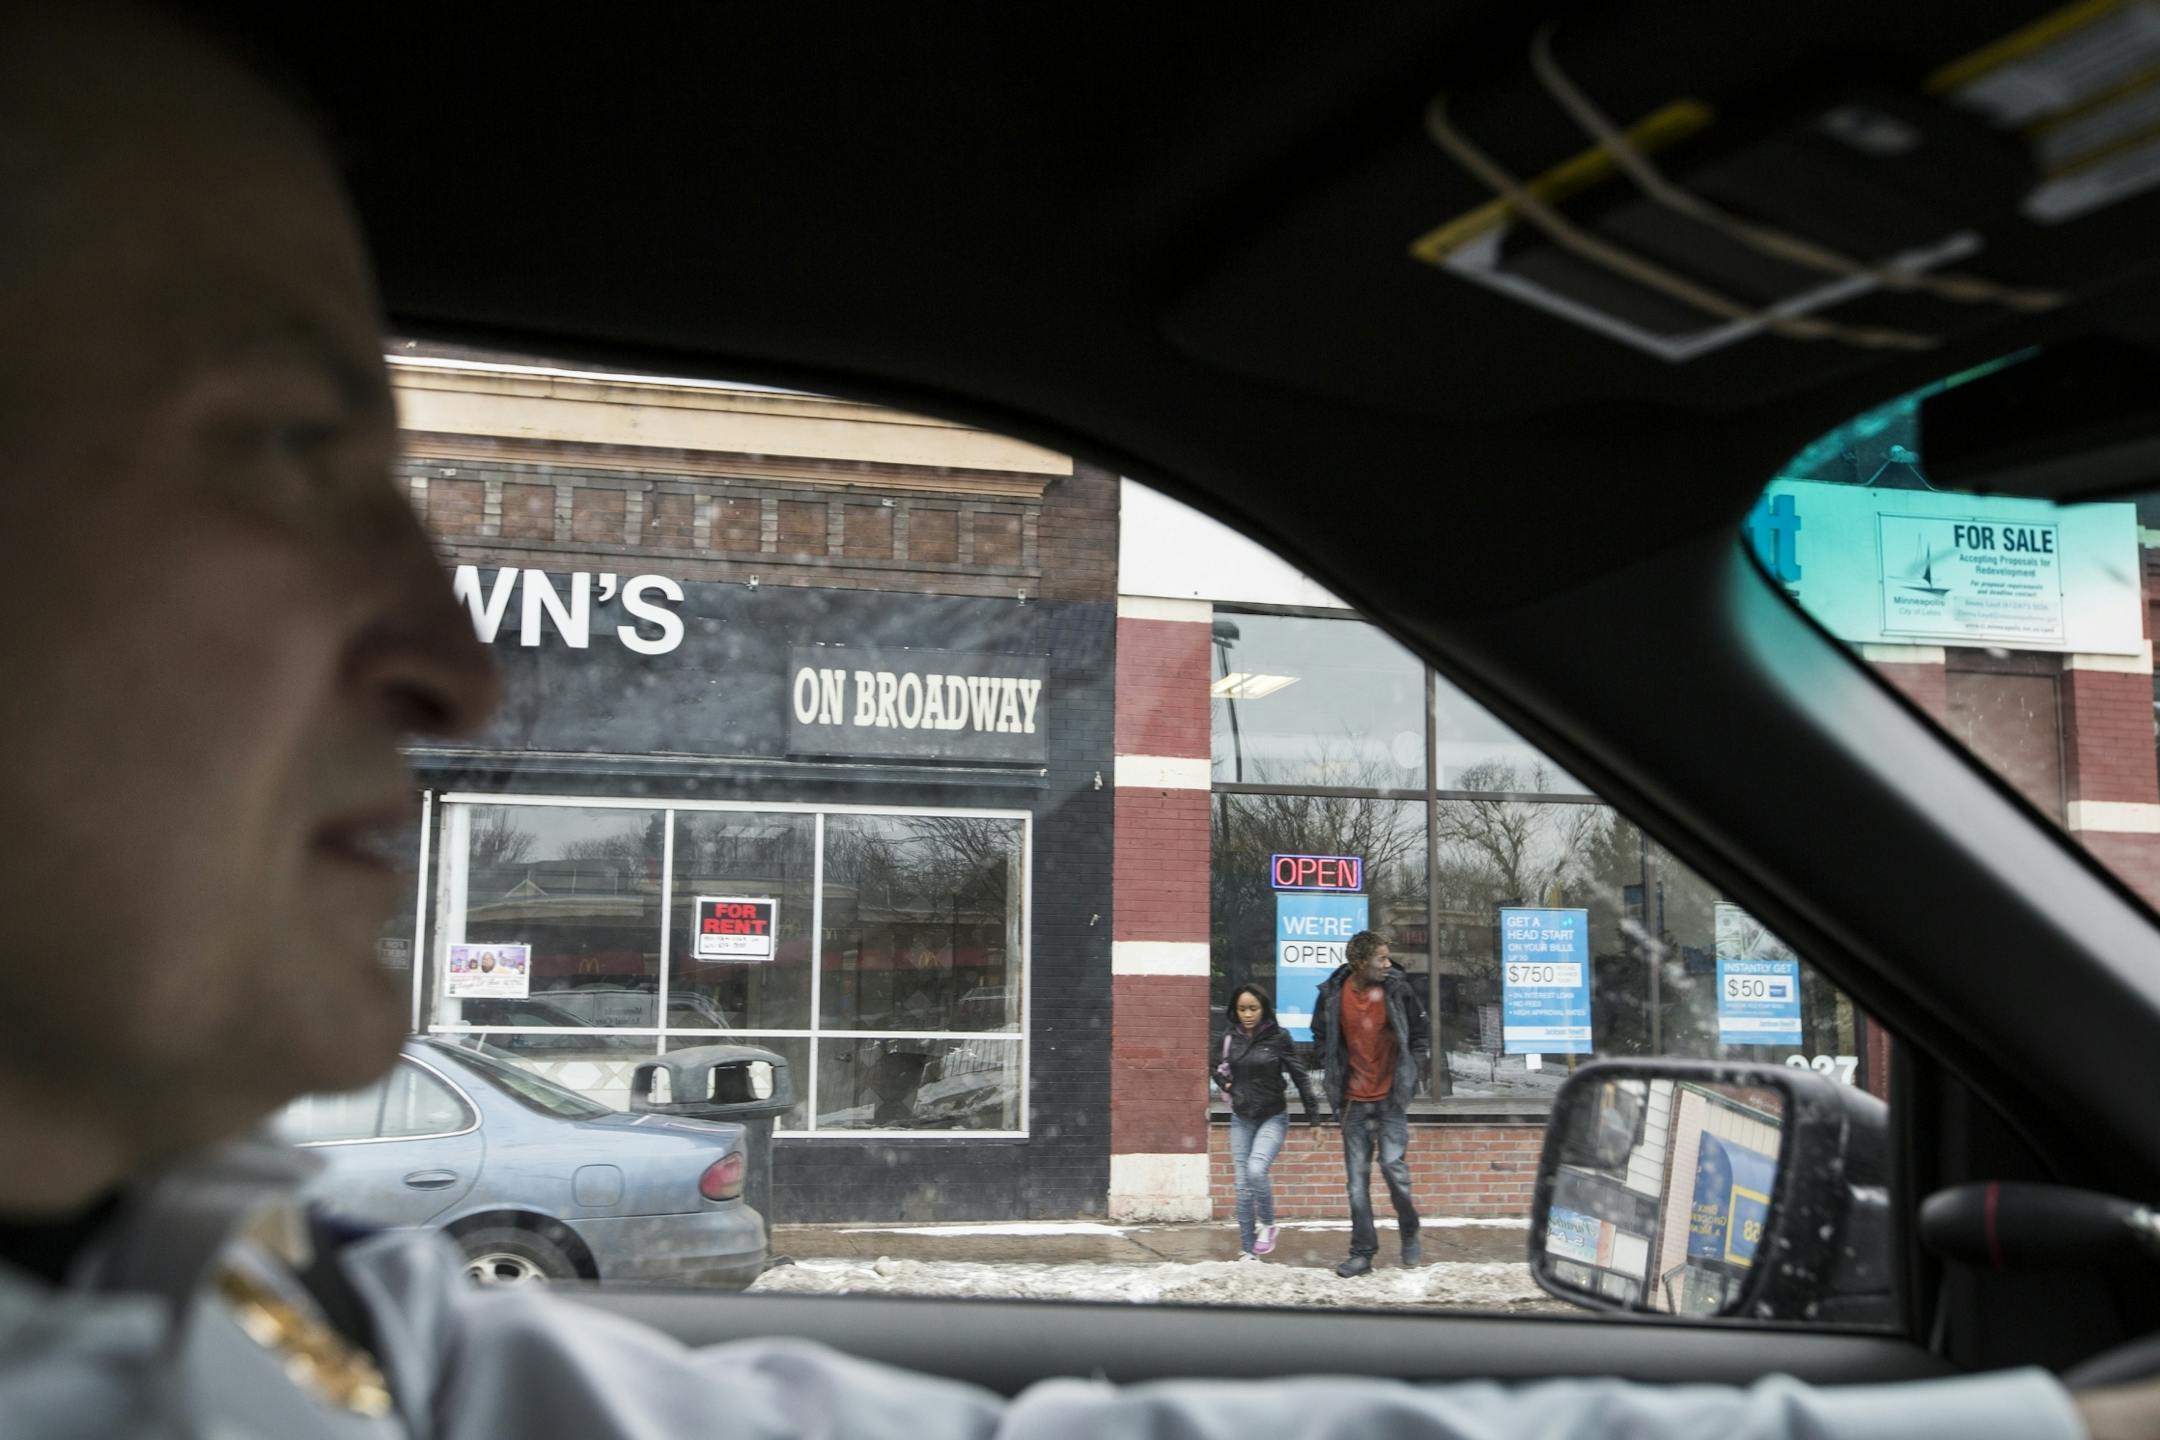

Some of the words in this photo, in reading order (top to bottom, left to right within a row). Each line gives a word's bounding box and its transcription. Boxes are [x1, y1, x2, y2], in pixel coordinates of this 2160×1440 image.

[1954, 525, 1995, 550] FOR
[2003, 527, 2054, 554] SALE
[1960, 554, 1997, 565] Accepting
[2000, 556, 2038, 567] Proposals
[2040, 558, 2051, 567] for
[1976, 565, 2036, 577] Redevelopment
[1893, 596, 1945, 607] Minneapolis
[793, 667, 847, 725] ON
[853, 671, 1042, 734] BROADWAY
[1276, 857, 1358, 888] OPEN
[715, 903, 757, 919] FOR
[703, 918, 768, 935] RENT
[1283, 916, 1353, 936] WE'RE
[1507, 916, 1530, 927] GET
[1532, 917, 1541, 927] A
[1507, 929, 1539, 940] HEAD
[1541, 930, 1575, 941] START
[1284, 945, 1343, 964] OPEN
[1507, 943, 1522, 951] ON
[1524, 943, 1548, 952] YOUR
[1508, 964, 1554, 983] $750
[1724, 963, 1771, 974] INSTANTLY
[1773, 964, 1793, 974] GET
[1727, 978, 1765, 998] $50
